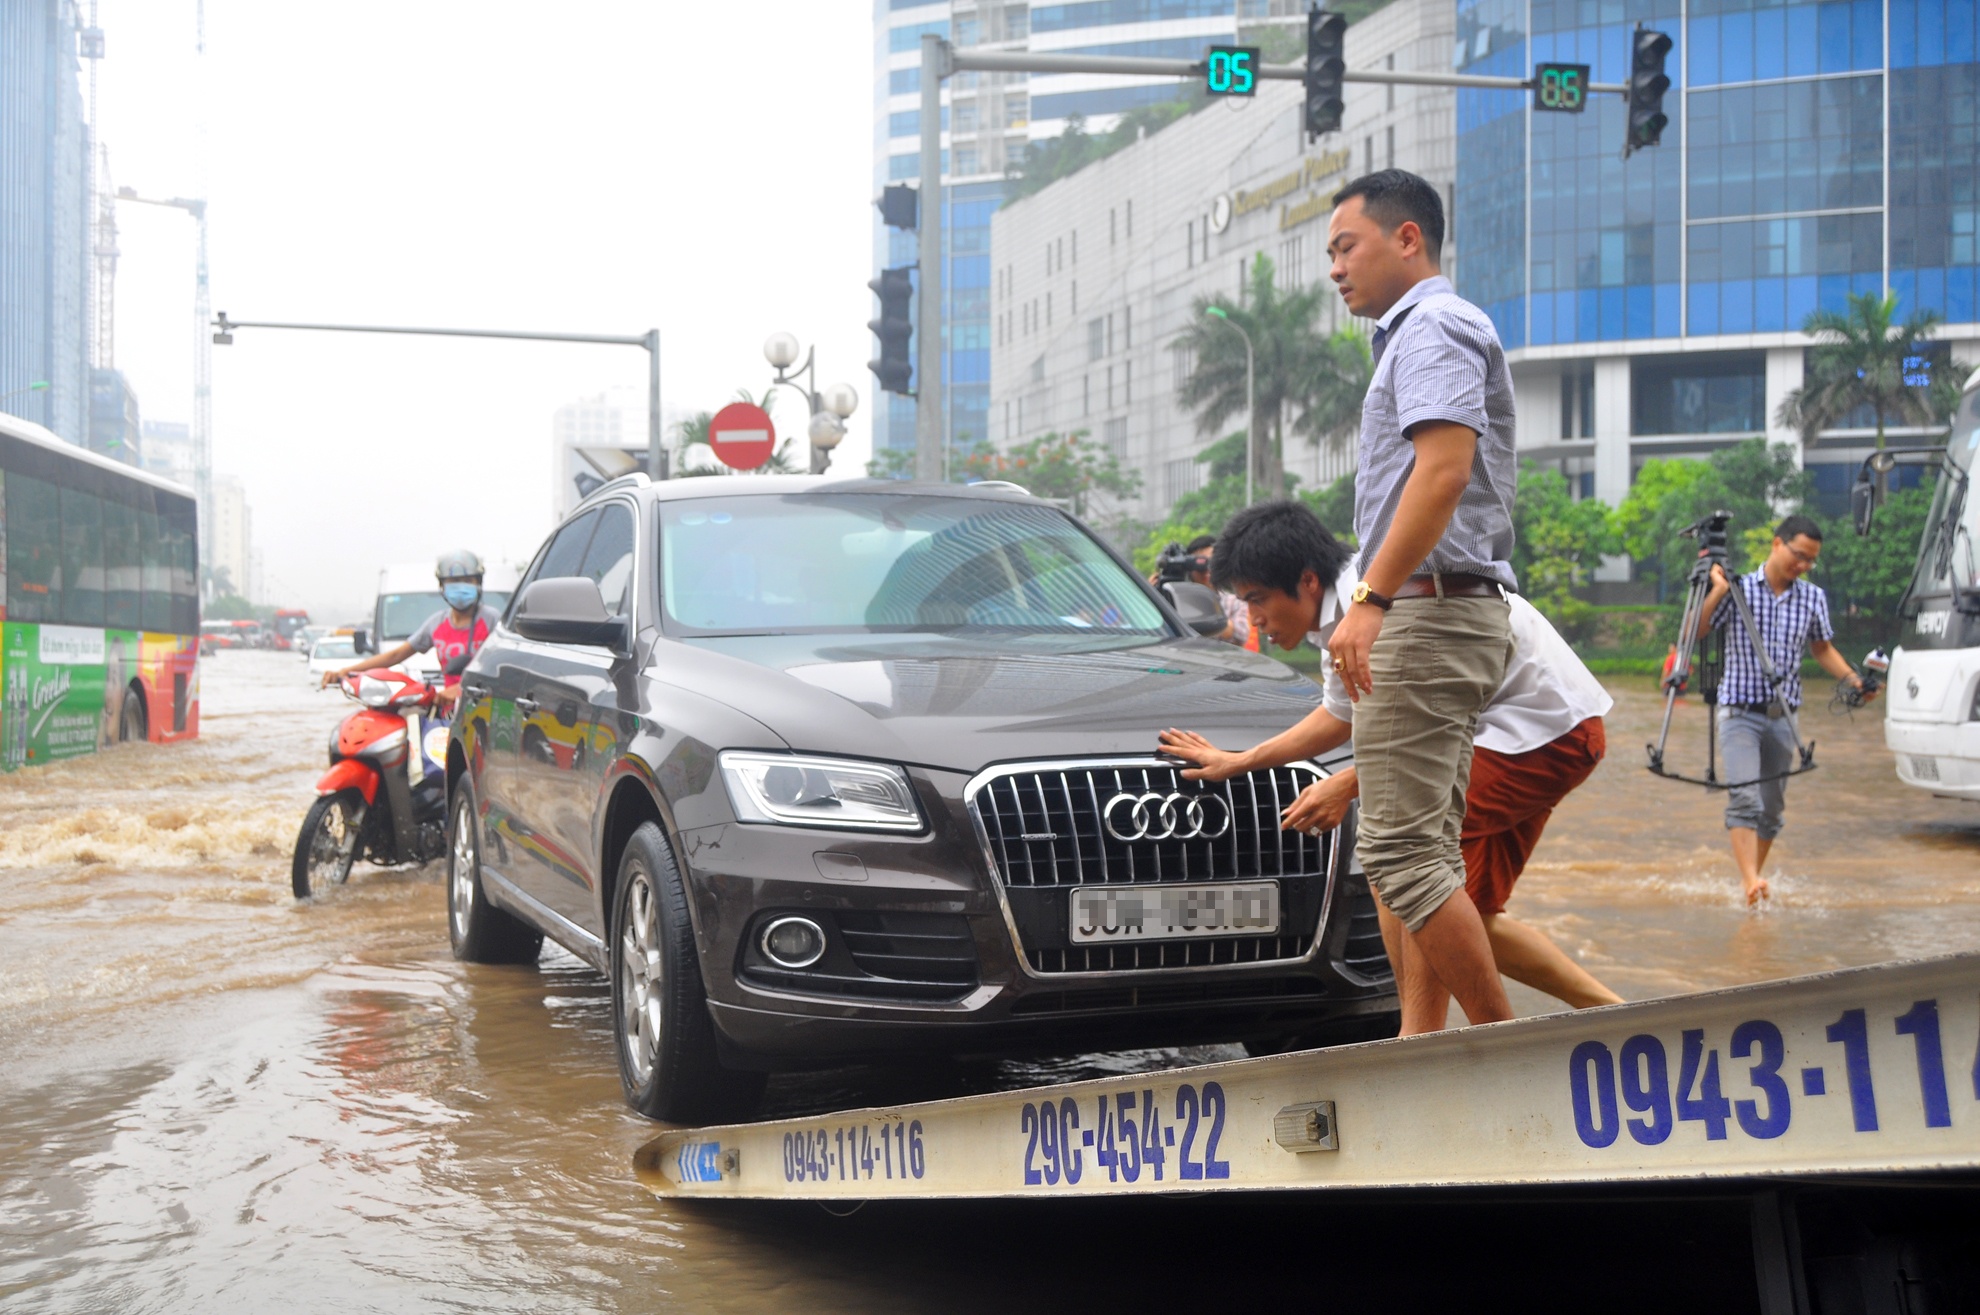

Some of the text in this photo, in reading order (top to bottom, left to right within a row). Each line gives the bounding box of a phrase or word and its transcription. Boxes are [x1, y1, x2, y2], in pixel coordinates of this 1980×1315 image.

[1208, 51, 1253, 93] 05
[1569, 998, 1980, 1149] 0943-11
[783, 1120, 924, 1182] 0943-114-116
[1022, 1081, 1229, 1186] 29C-454-22
